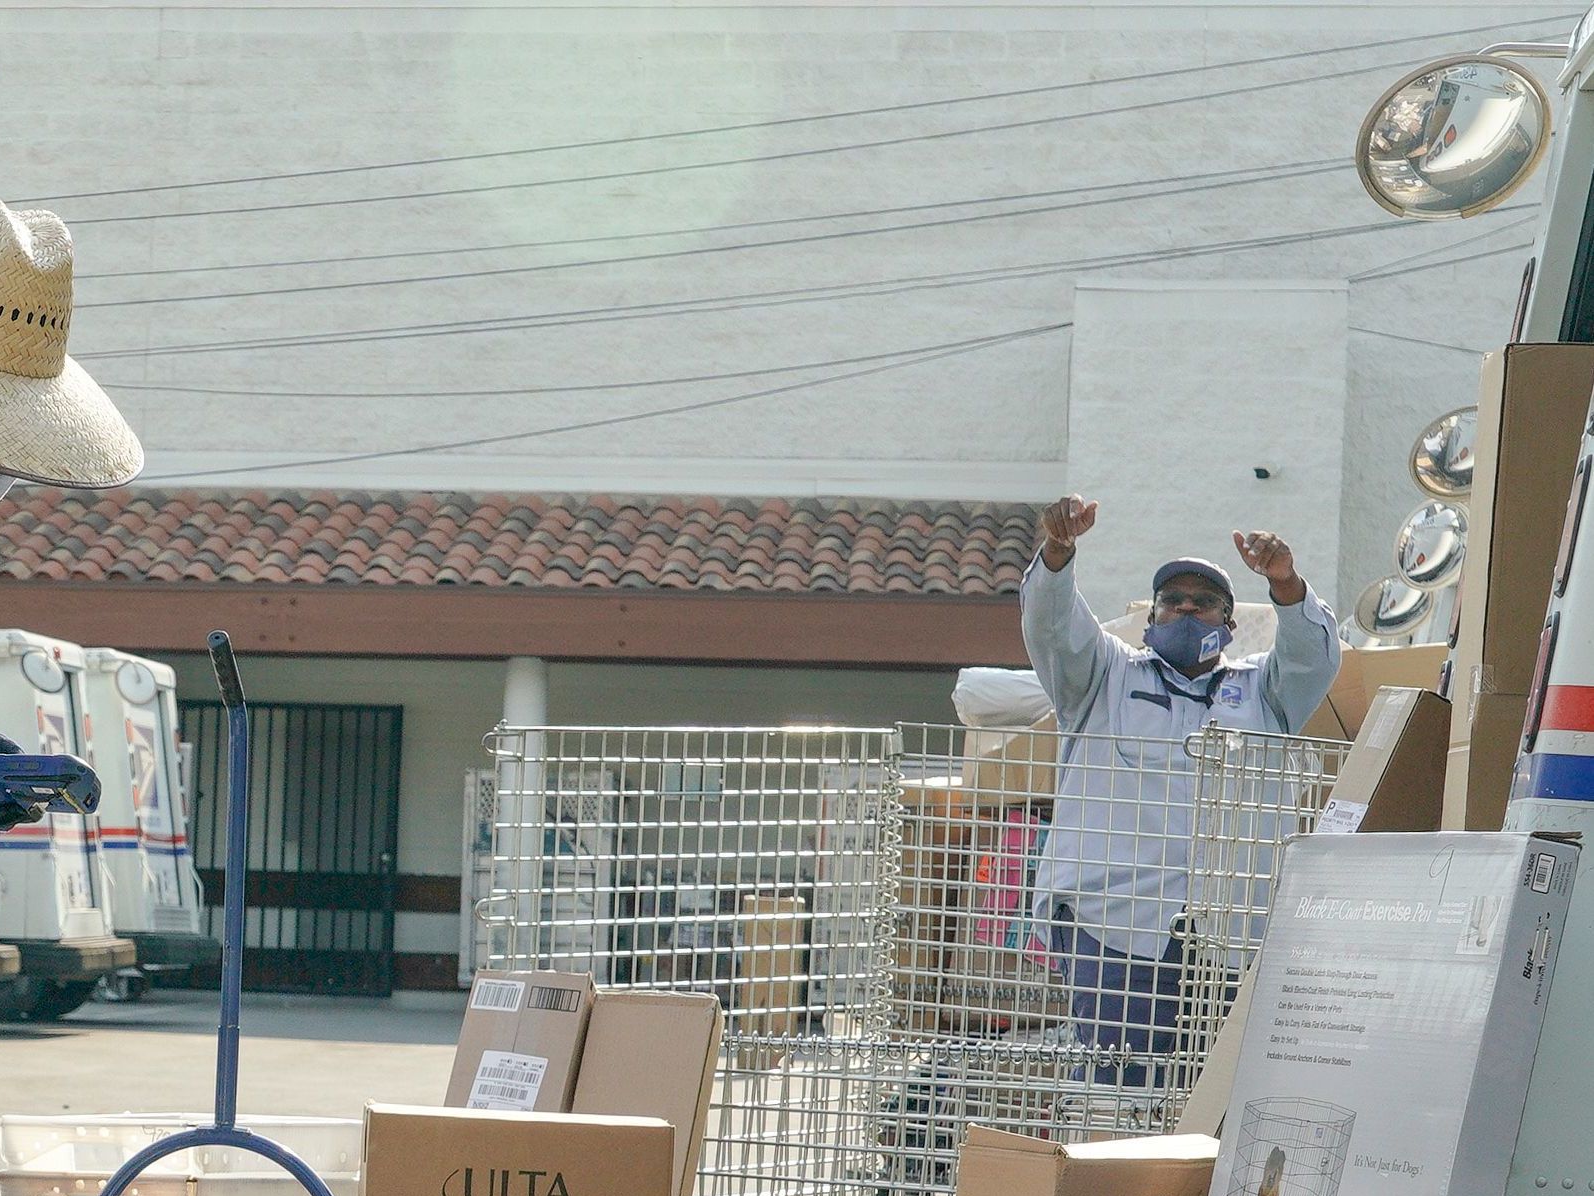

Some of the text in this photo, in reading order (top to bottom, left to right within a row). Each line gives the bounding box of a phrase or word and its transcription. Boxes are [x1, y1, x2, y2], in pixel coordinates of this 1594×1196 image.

[1326, 802, 1336, 814] P
[1294, 896, 1432, 922] Black E-Coat Exercise Pen
[1278, 1001, 1286, 1009] Can
[1274, 1018, 1284, 1026] Easy
[1328, 1022, 1349, 1031] Convenient
[1350, 1024, 1365, 1034] Storage
[1270, 1034, 1280, 1043] Easy
[1293, 1037, 1299, 1045] Up
[1267, 1051, 1283, 1059] Includes
[1284, 1052, 1297, 1060] Ground
[1298, 1054, 1313, 1062] Anchors
[1313, 1055, 1317, 1063] &
[1331, 1056, 1351, 1066] Stabilizers
[1355, 1155, 1423, 1178] It's Not Just for Dogs!
